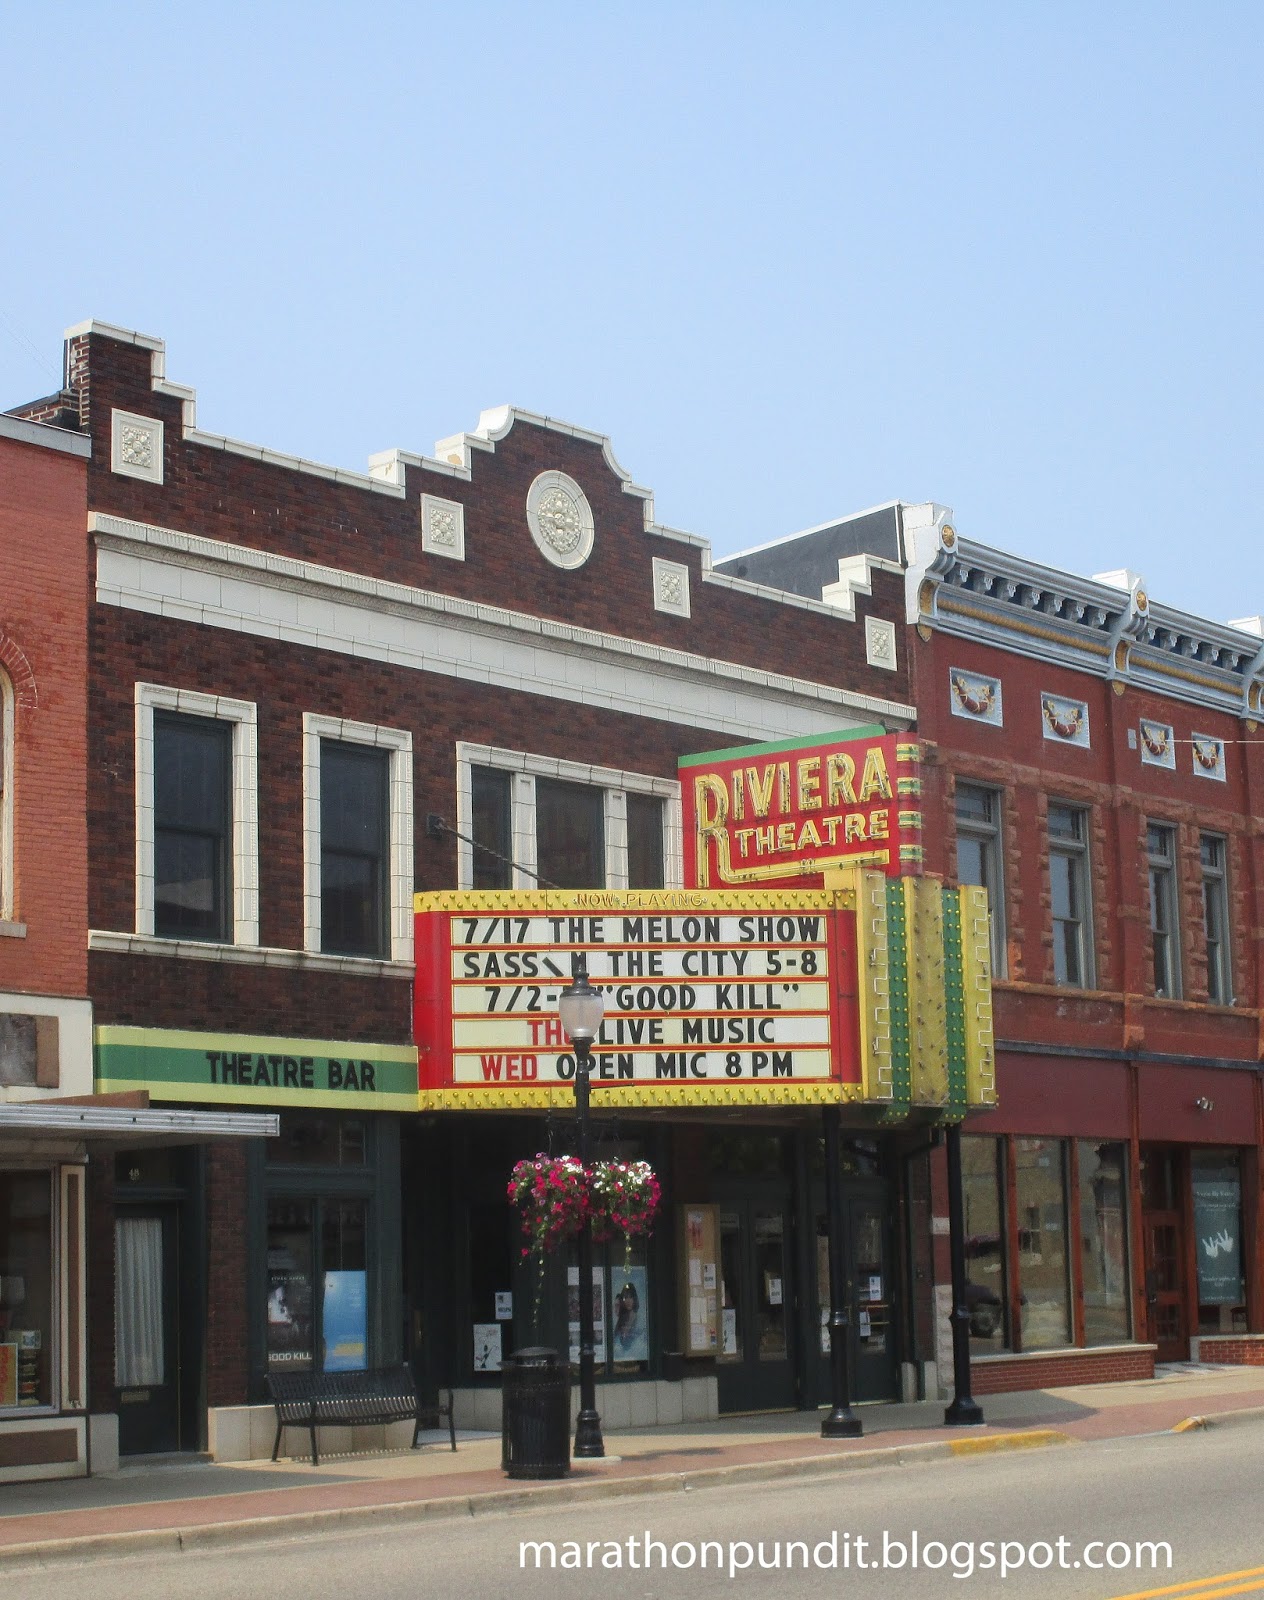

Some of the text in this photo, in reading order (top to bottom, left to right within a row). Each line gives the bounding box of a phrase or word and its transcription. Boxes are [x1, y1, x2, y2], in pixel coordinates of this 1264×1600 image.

[694, 747, 893, 888] RIVIERA
[734, 809, 890, 858] THEATRE
[577, 892, 703, 907] NOW PLAYING
[463, 917, 820, 944] 7/17 THE MELON SHOW
[608, 951, 664, 977] THE
[682, 950, 749, 976] CITY
[767, 950, 818, 976] 5-8
[599, 1019, 664, 1045] LIVE
[683, 1018, 775, 1044] MUSIC
[206, 1051, 376, 1092] THEATRE BAR
[481, 1054, 538, 1081] WED
[656, 1052, 707, 1078] MIC
[293, 1352, 313, 1361] KILL
